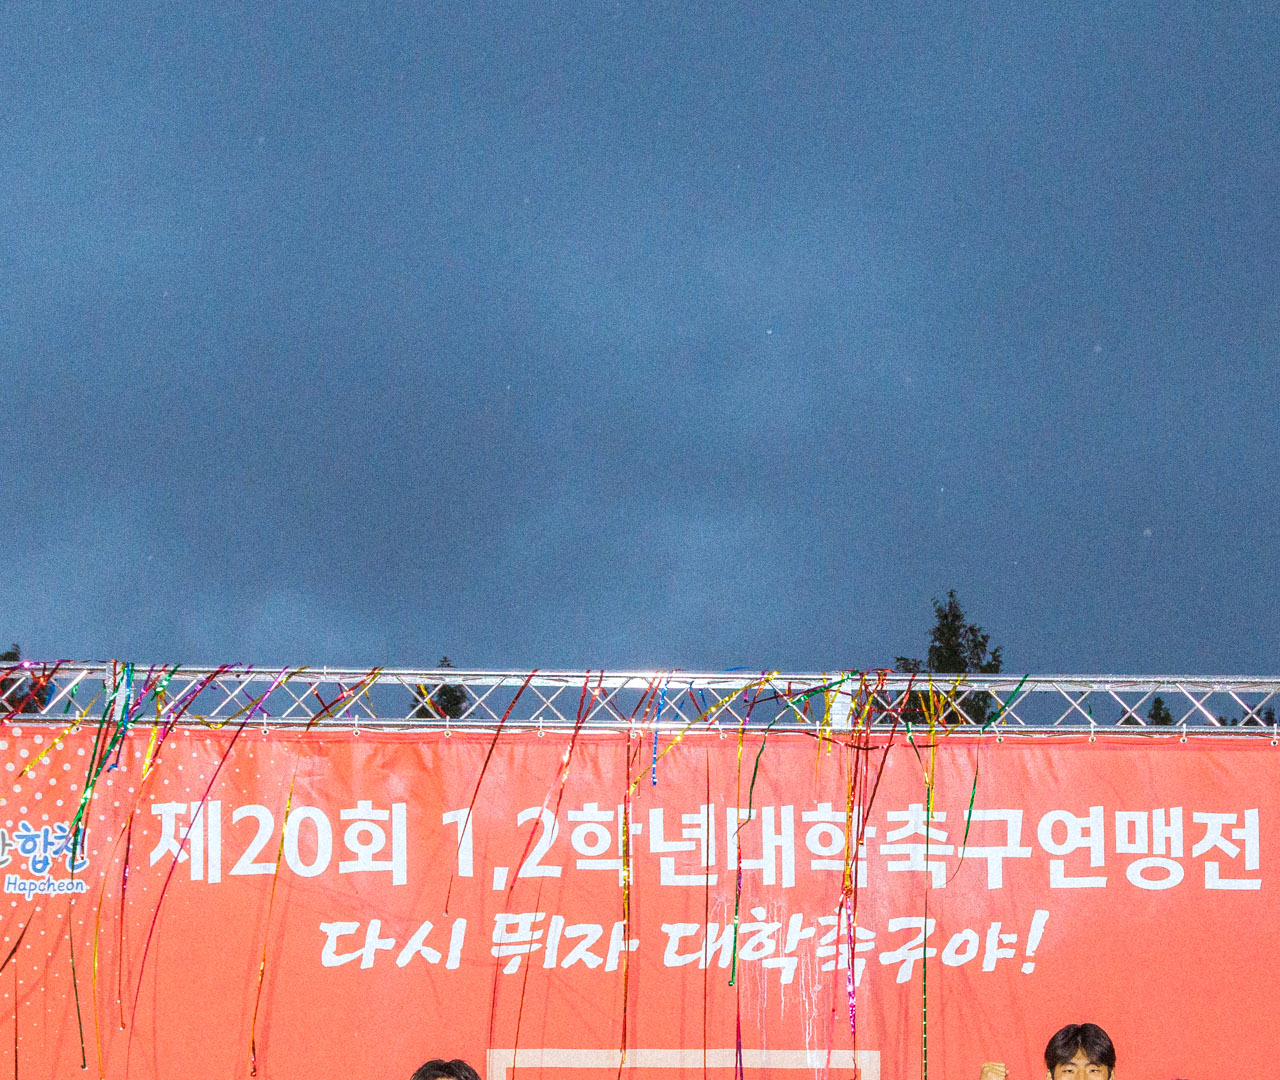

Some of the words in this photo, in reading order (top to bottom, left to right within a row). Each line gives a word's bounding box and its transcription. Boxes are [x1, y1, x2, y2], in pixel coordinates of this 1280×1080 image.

[150, 800, 407, 886] 제20회
[442, 801, 1262, 891] 1,2학년대학축구연맹전
[4, 875, 86, 898] Hapcheon
[319, 917, 466, 970] 다시
[491, 912, 639, 975] 뛰자
[660, 907, 1050, 984] 대학축구야!
